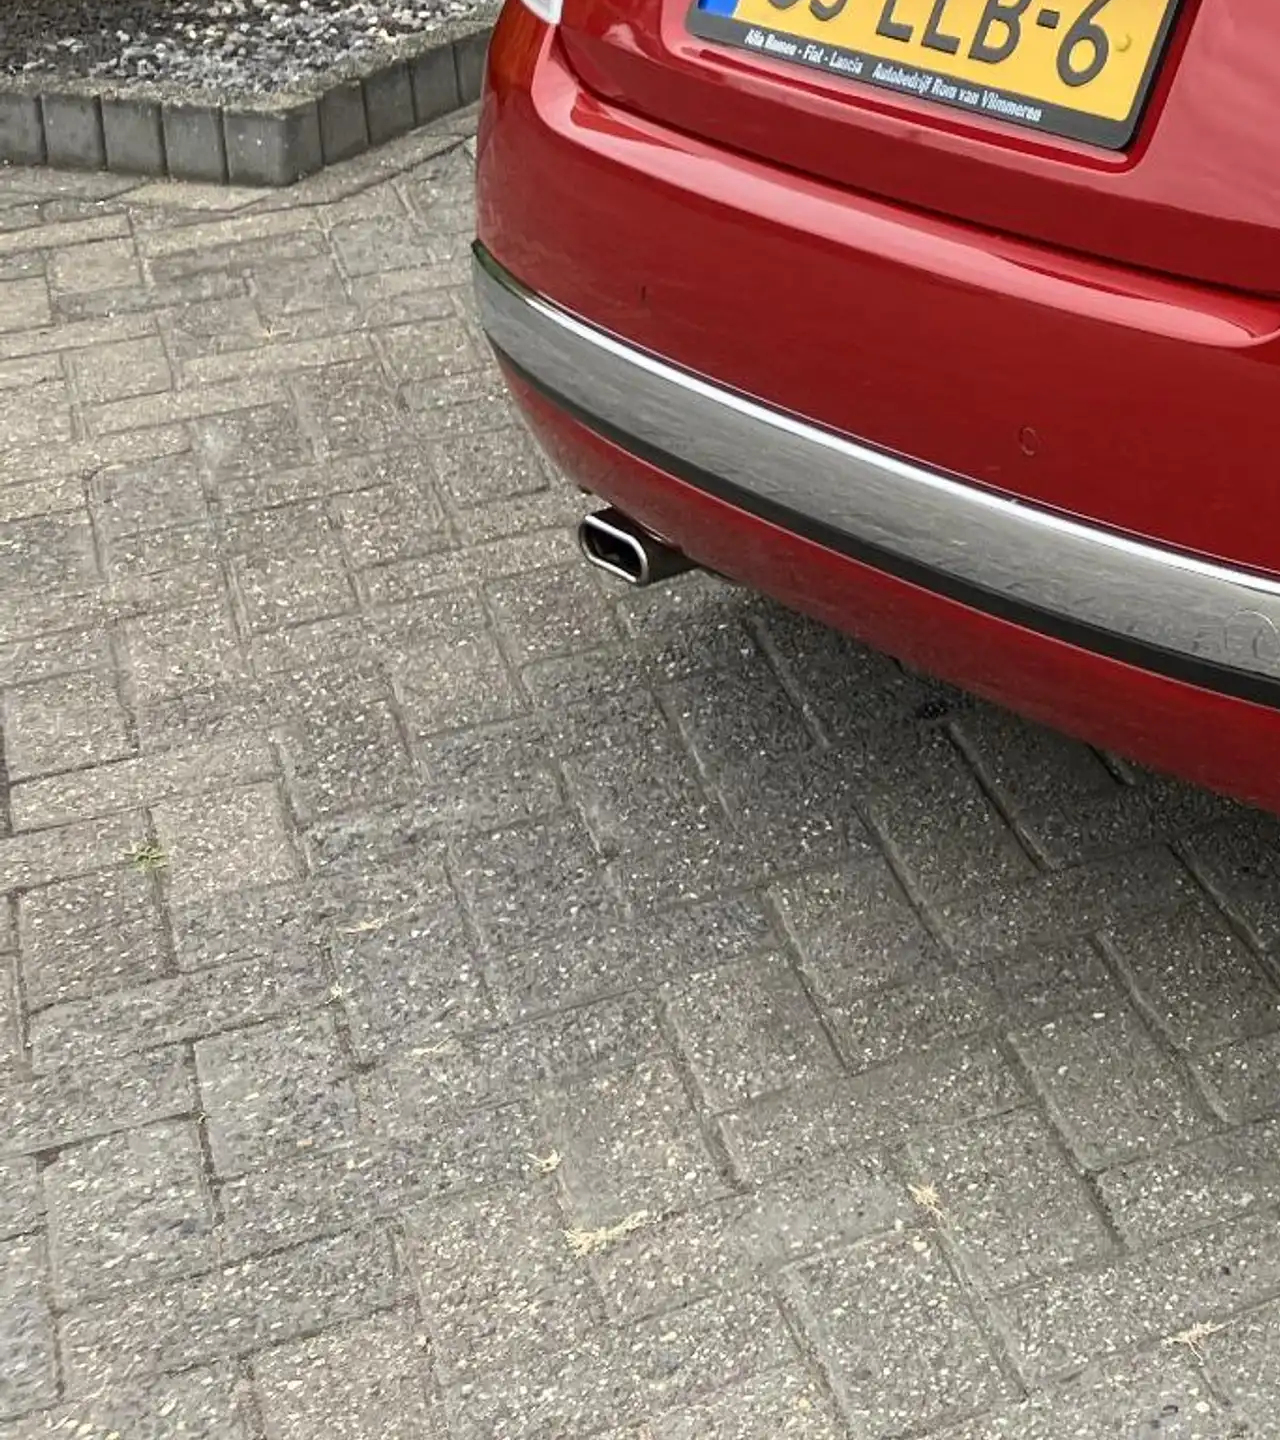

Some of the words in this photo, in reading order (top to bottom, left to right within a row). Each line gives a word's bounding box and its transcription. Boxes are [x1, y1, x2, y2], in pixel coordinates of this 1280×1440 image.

[803, 43, 825, 64] Fiat
[829, 50, 864, 75] Lancia
[872, 62, 933, 94] Autobedrijf
[958, 88, 980, 105] van
